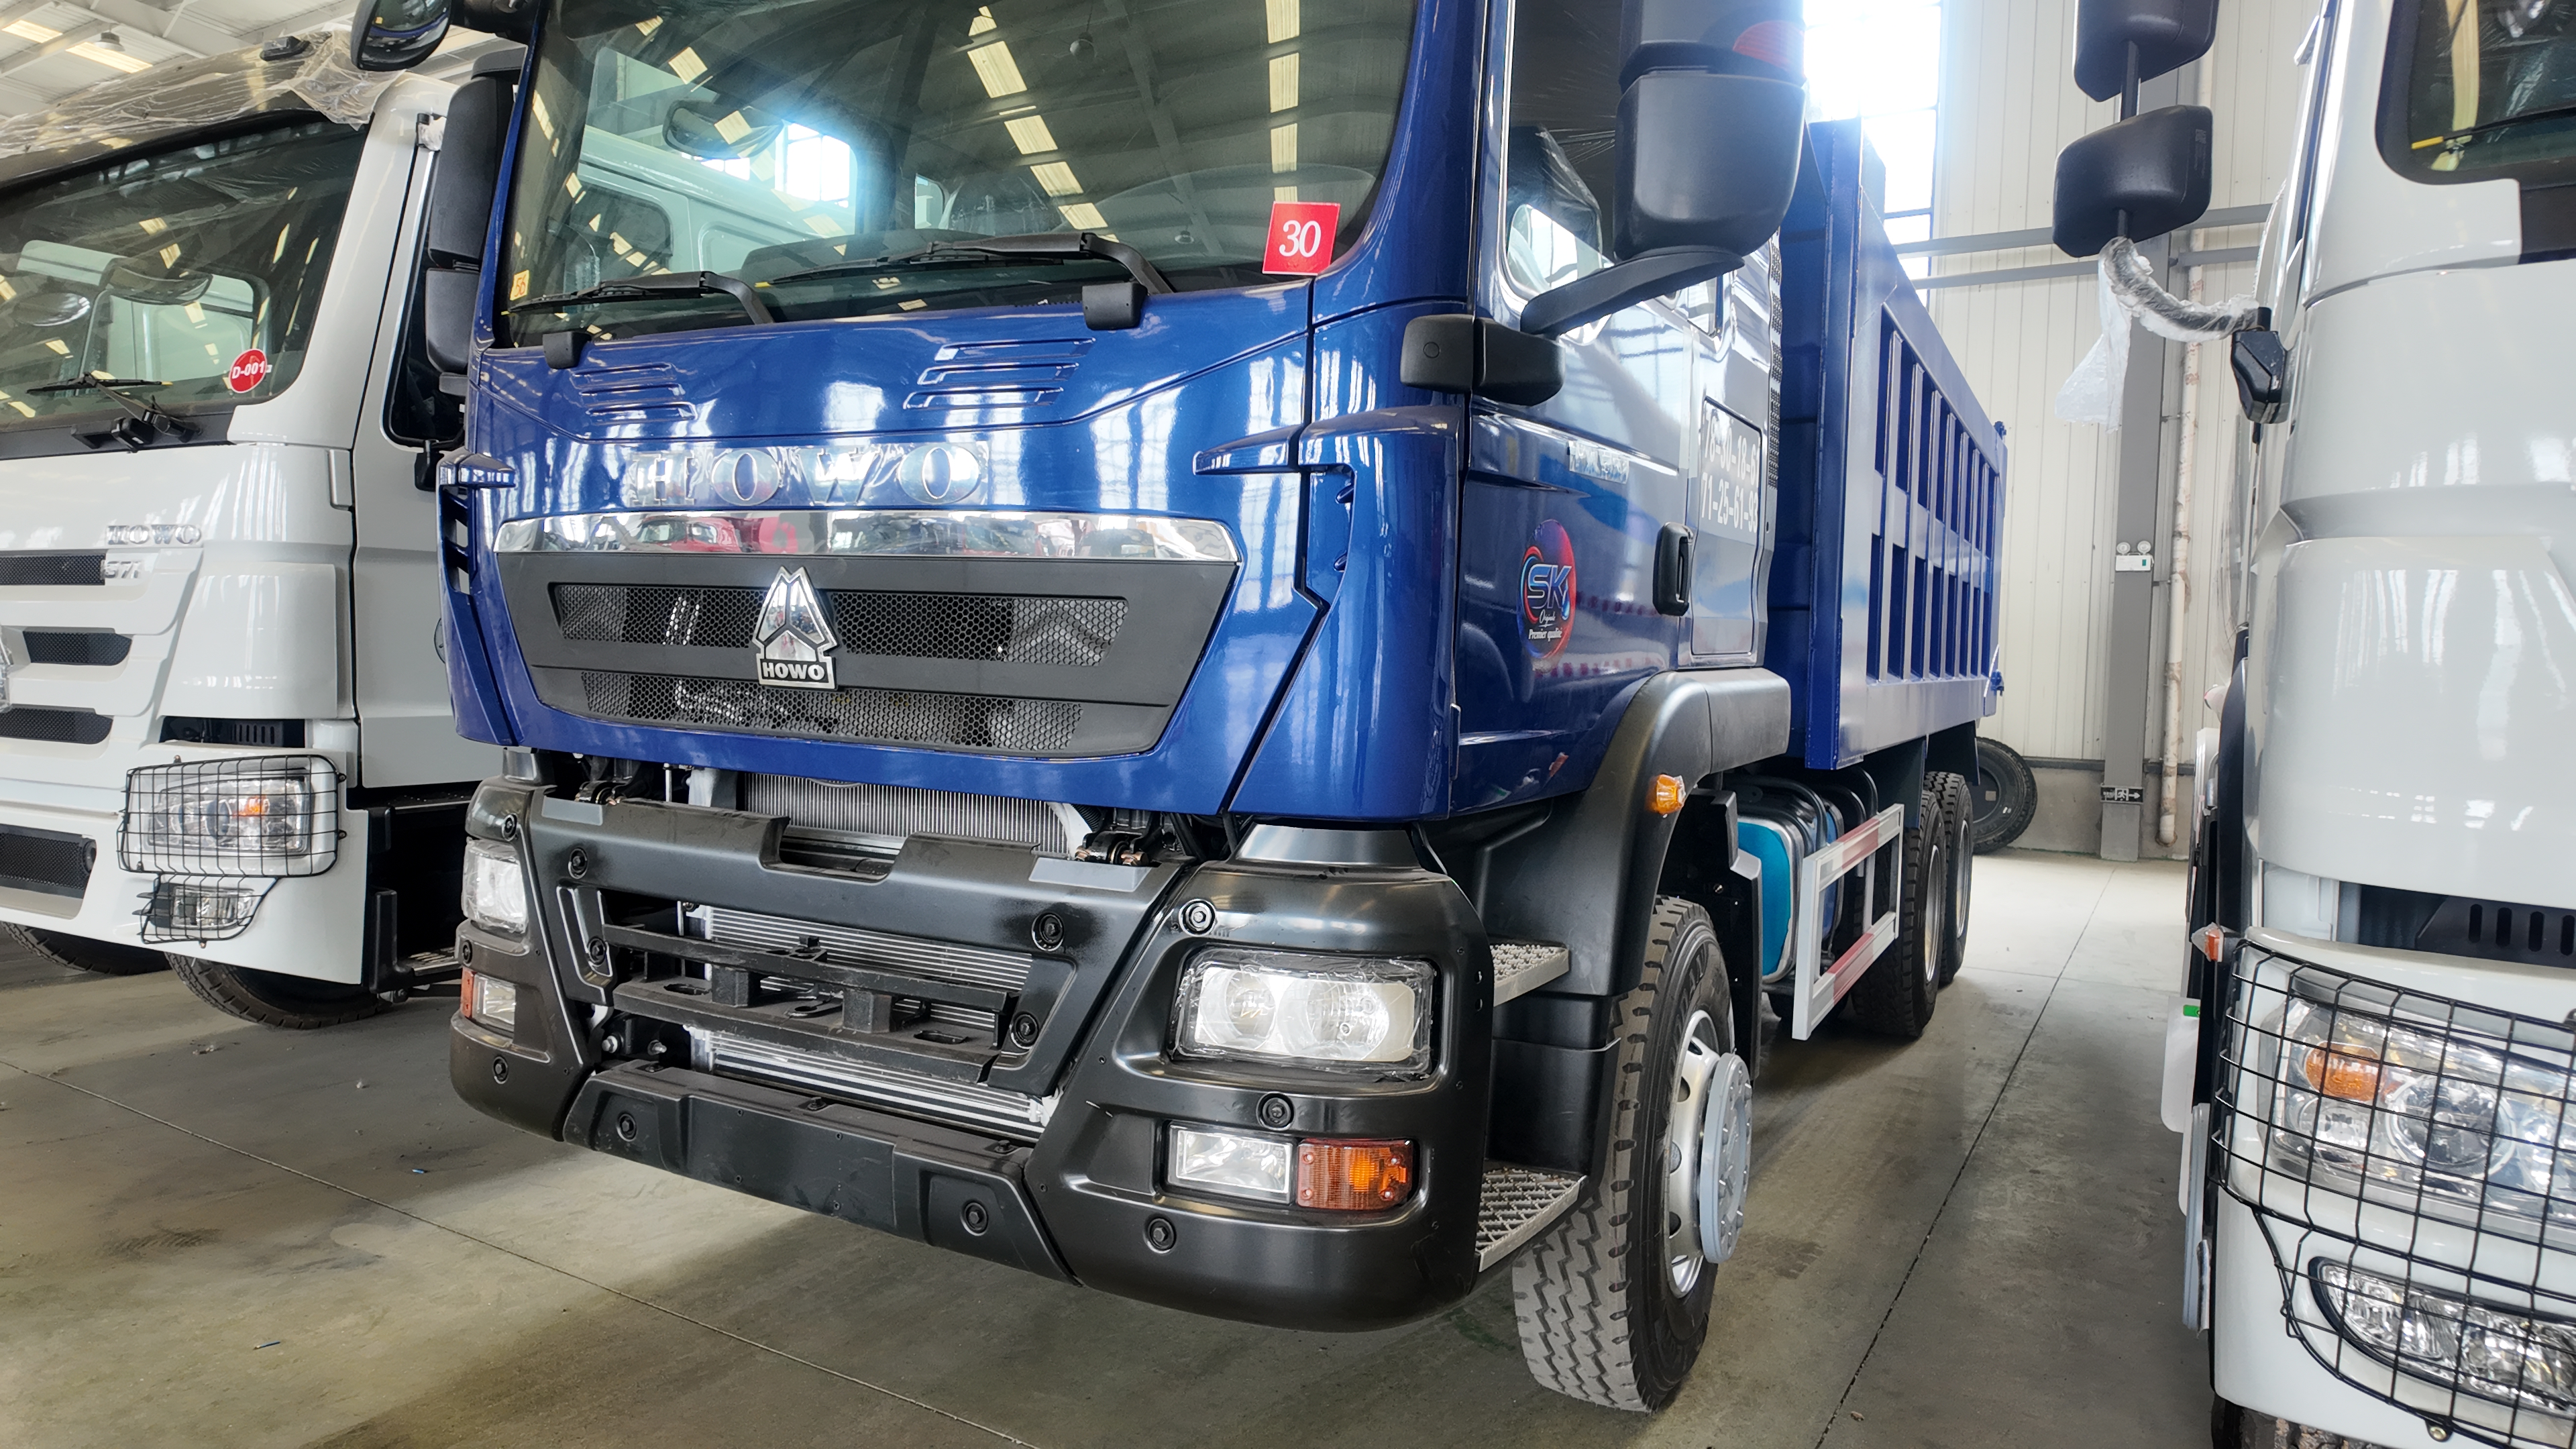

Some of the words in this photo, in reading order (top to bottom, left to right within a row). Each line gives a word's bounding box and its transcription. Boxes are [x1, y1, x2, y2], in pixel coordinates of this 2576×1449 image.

[1279, 220, 1322, 258] 30
[514, 274, 526, 297] 56
[231, 360, 266, 379] D-001
[631, 440, 982, 506] HOWO
[1701, 471, 1759, 534] 71-25-61-93
[106, 525, 202, 545] HOWO
[1527, 564, 1572, 609] SK
[761, 661, 825, 680] HOWO
